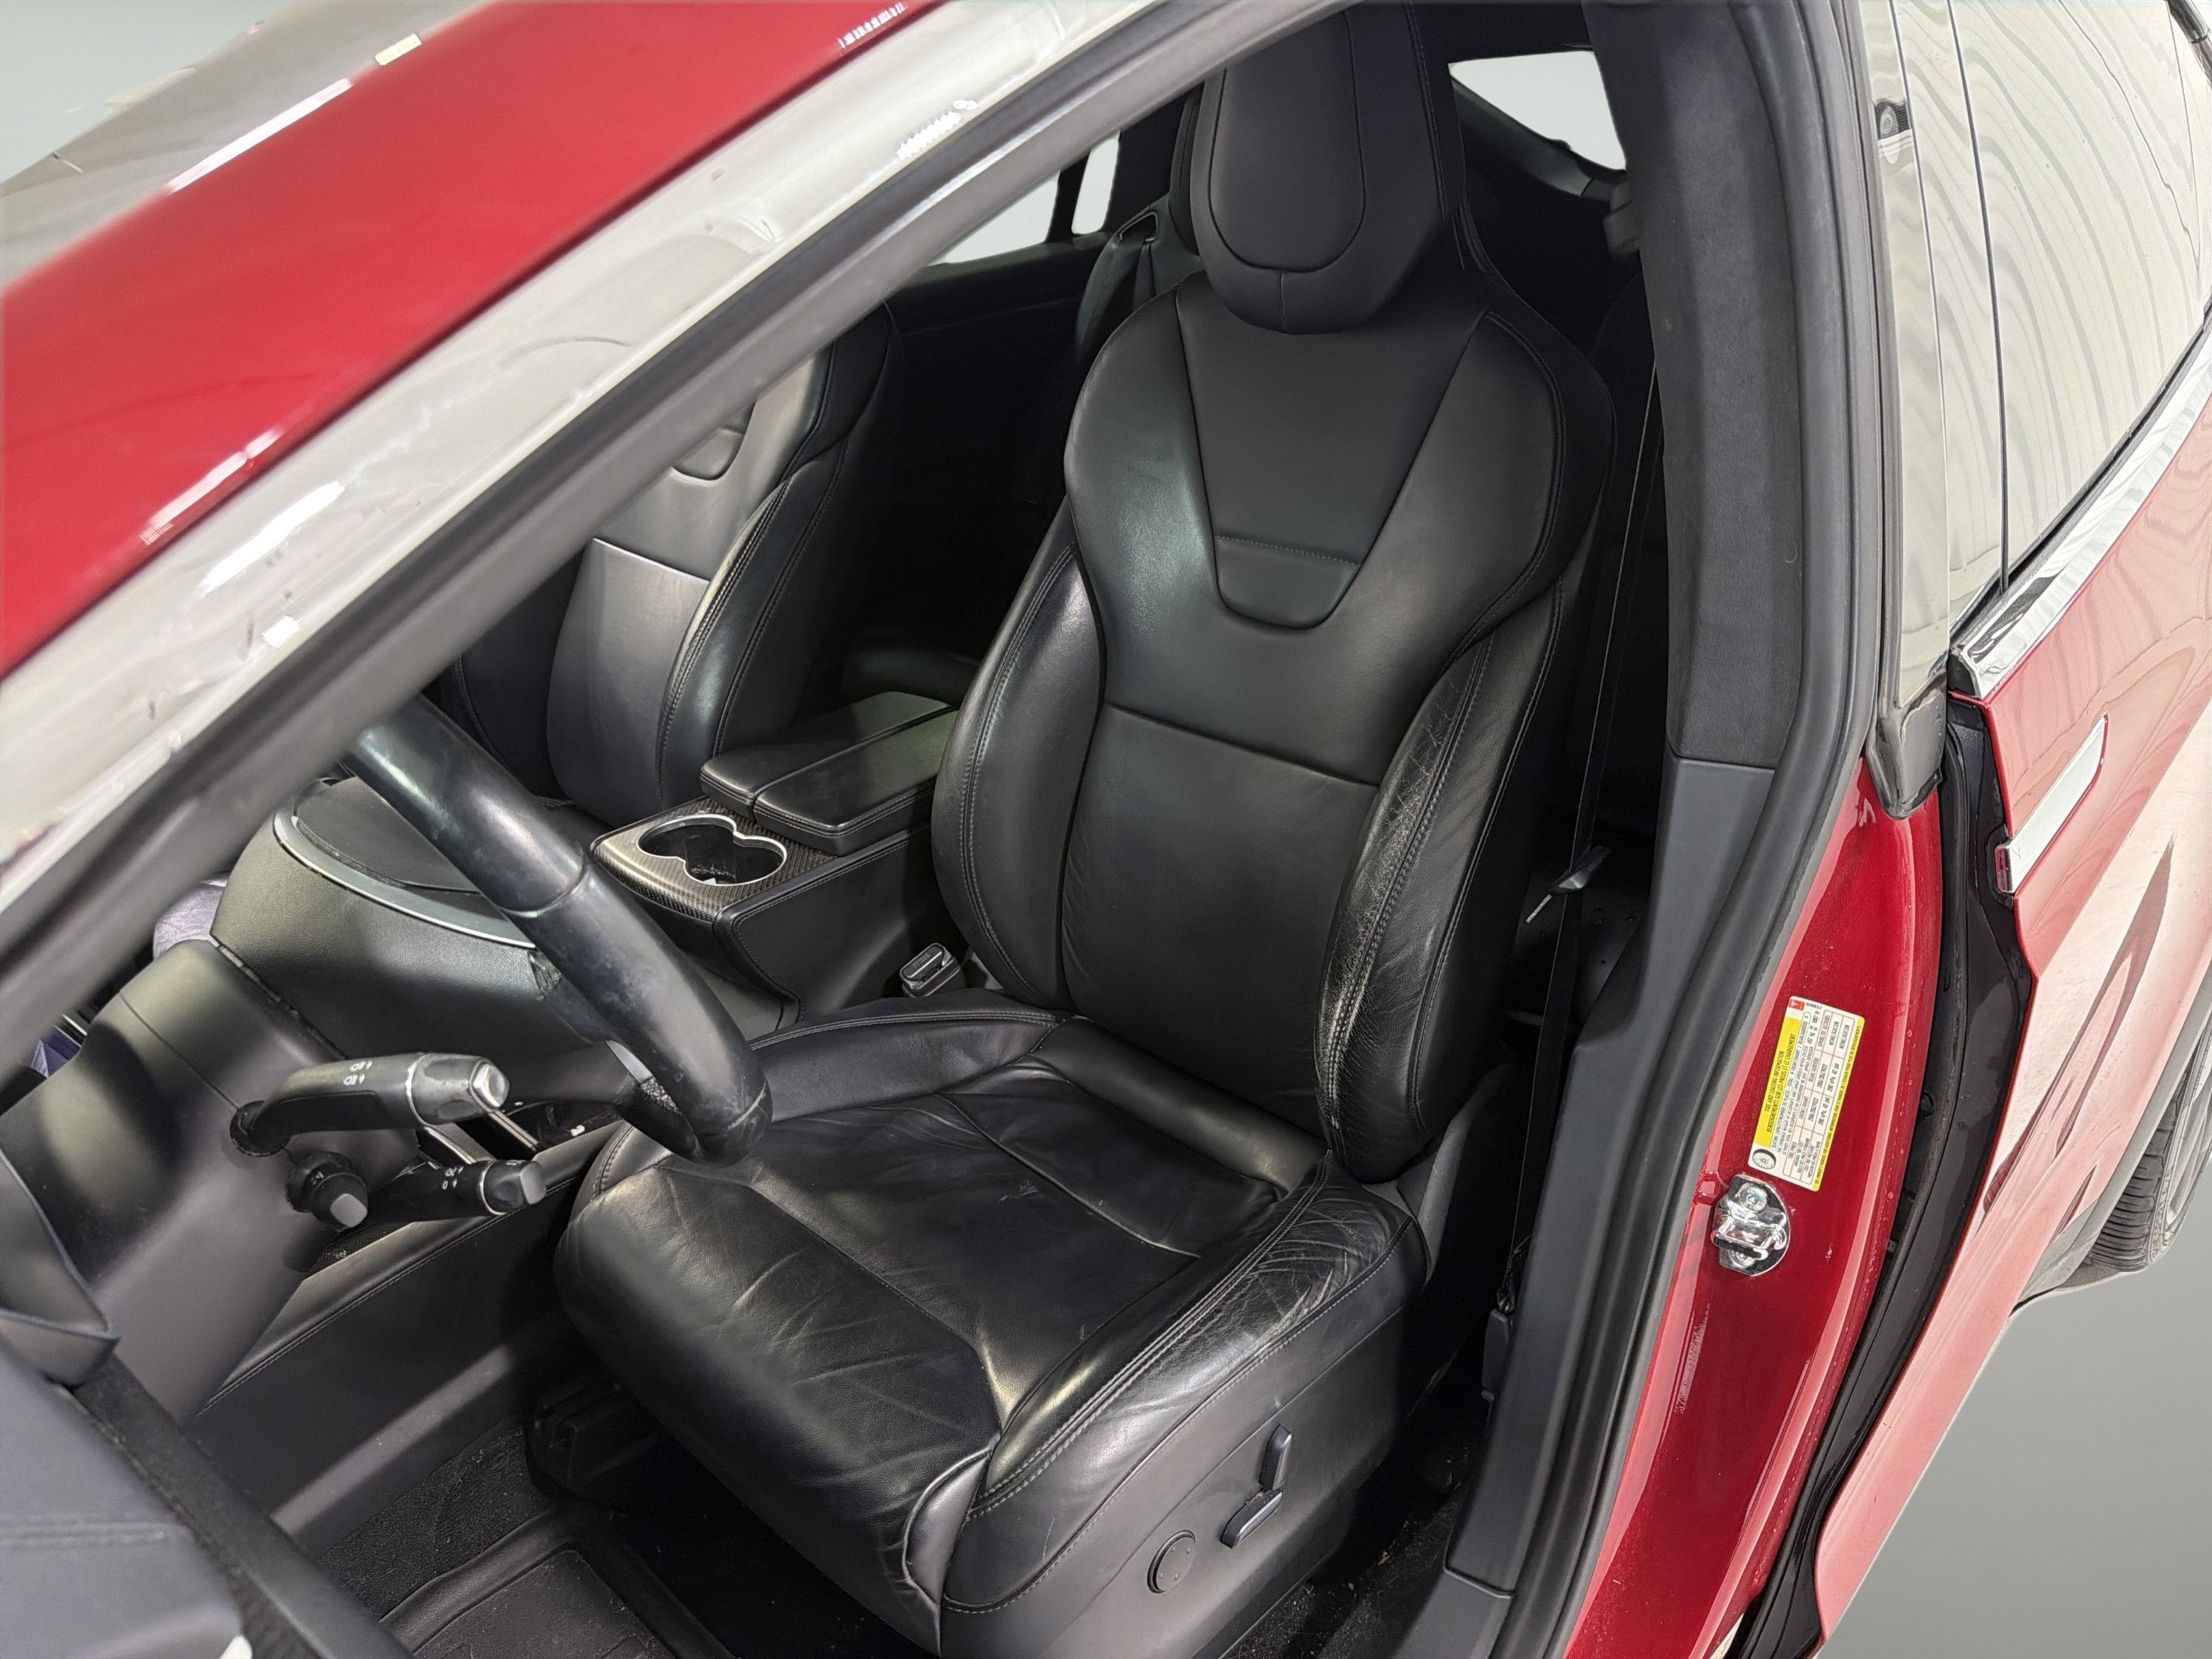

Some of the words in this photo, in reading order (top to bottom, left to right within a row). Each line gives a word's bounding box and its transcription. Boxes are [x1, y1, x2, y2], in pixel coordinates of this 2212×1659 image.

[1765, 1099, 1778, 1133] RENSEIGNEMENTS
[1778, 1070, 1787, 1084] PNEUS
[1784, 1033, 1795, 1060] CHARGEMENT
[1768, 1077, 1778, 1094] LOADING
[1773, 1050, 1784, 1077] INFORMATION
[1770, 1135, 1778, 1149] SEATING
